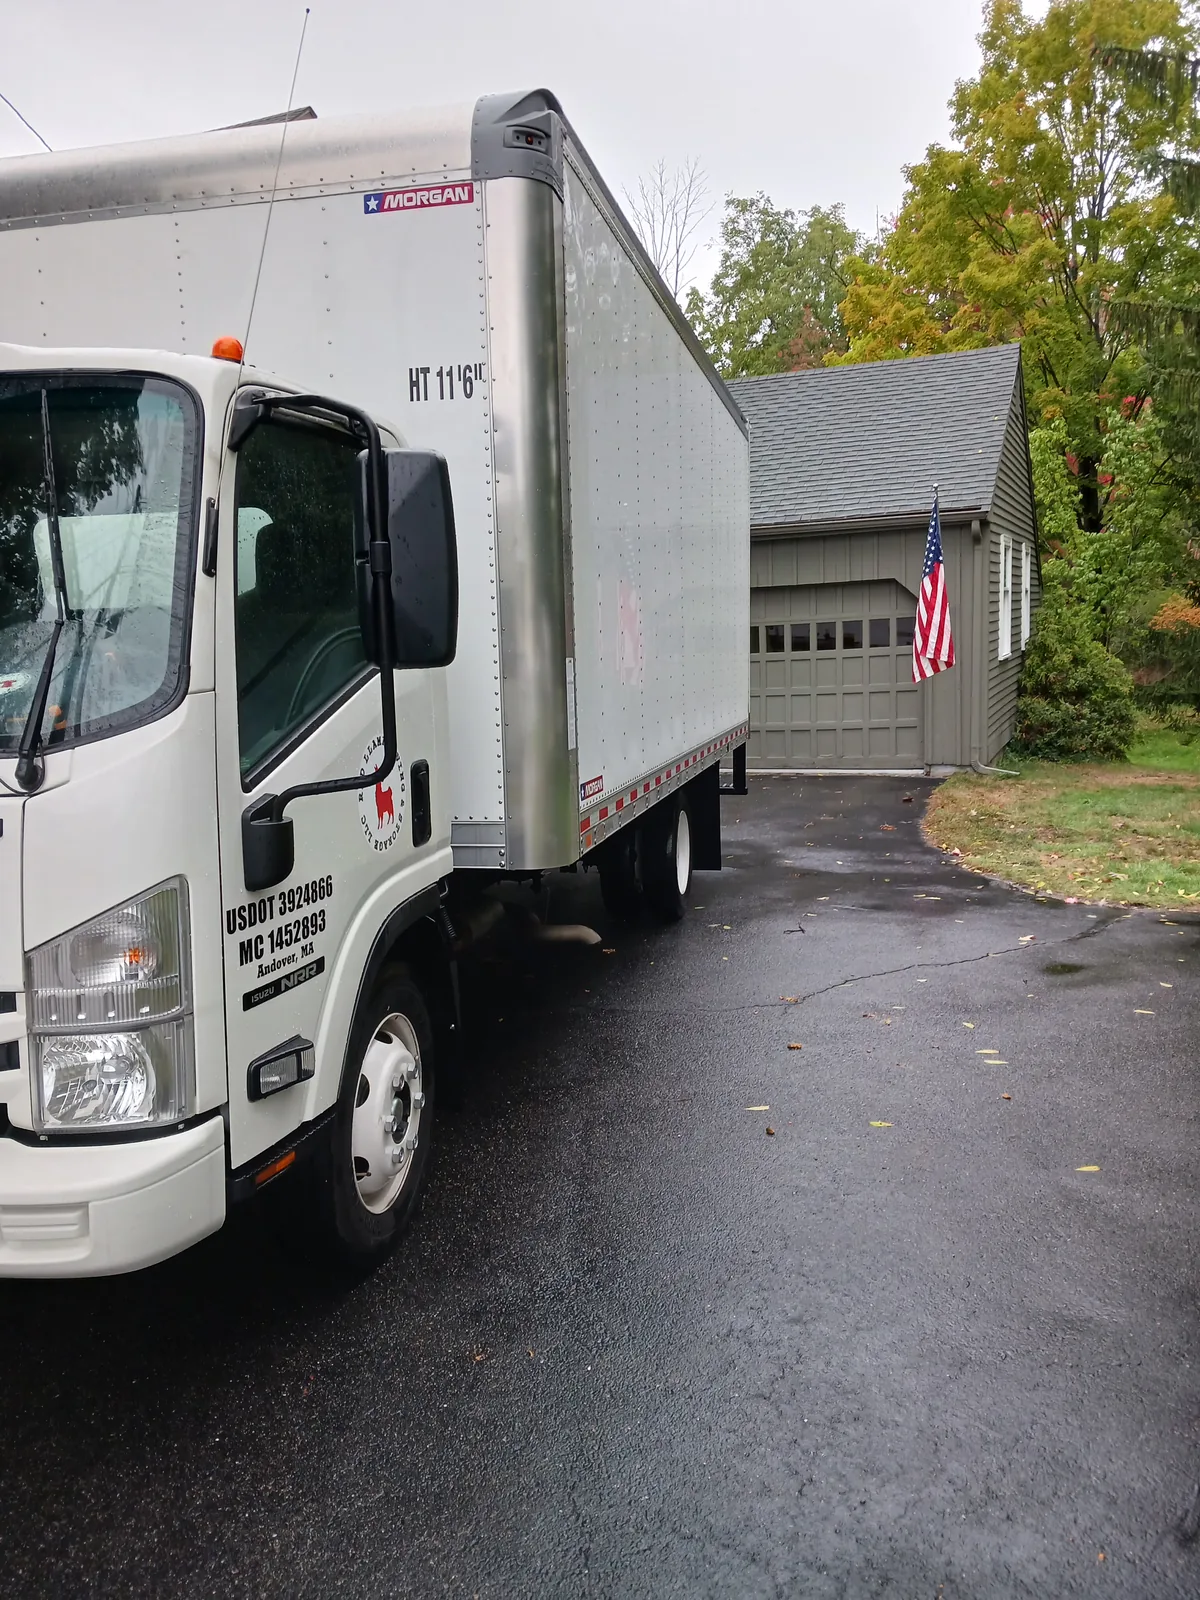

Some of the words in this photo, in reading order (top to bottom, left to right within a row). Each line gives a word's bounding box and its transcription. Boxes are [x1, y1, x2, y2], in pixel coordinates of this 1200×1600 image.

[383, 186, 469, 209] MORGAN
[408, 366, 431, 402] HT
[436, 363, 483, 400] 11'6"
[585, 778, 603, 798] MORGAN
[361, 814, 373, 843] LLC
[374, 813, 403, 851] STORAGE
[226, 895, 276, 935] USDOT
[278, 874, 333, 916] 3924866
[239, 934, 265, 967] MC
[267, 909, 326, 954] 1452893
[256, 952, 299, 979] Andover,
[300, 941, 315, 959] MA
[251, 985, 275, 1004] ISUZU
[281, 963, 317, 992] NRR
